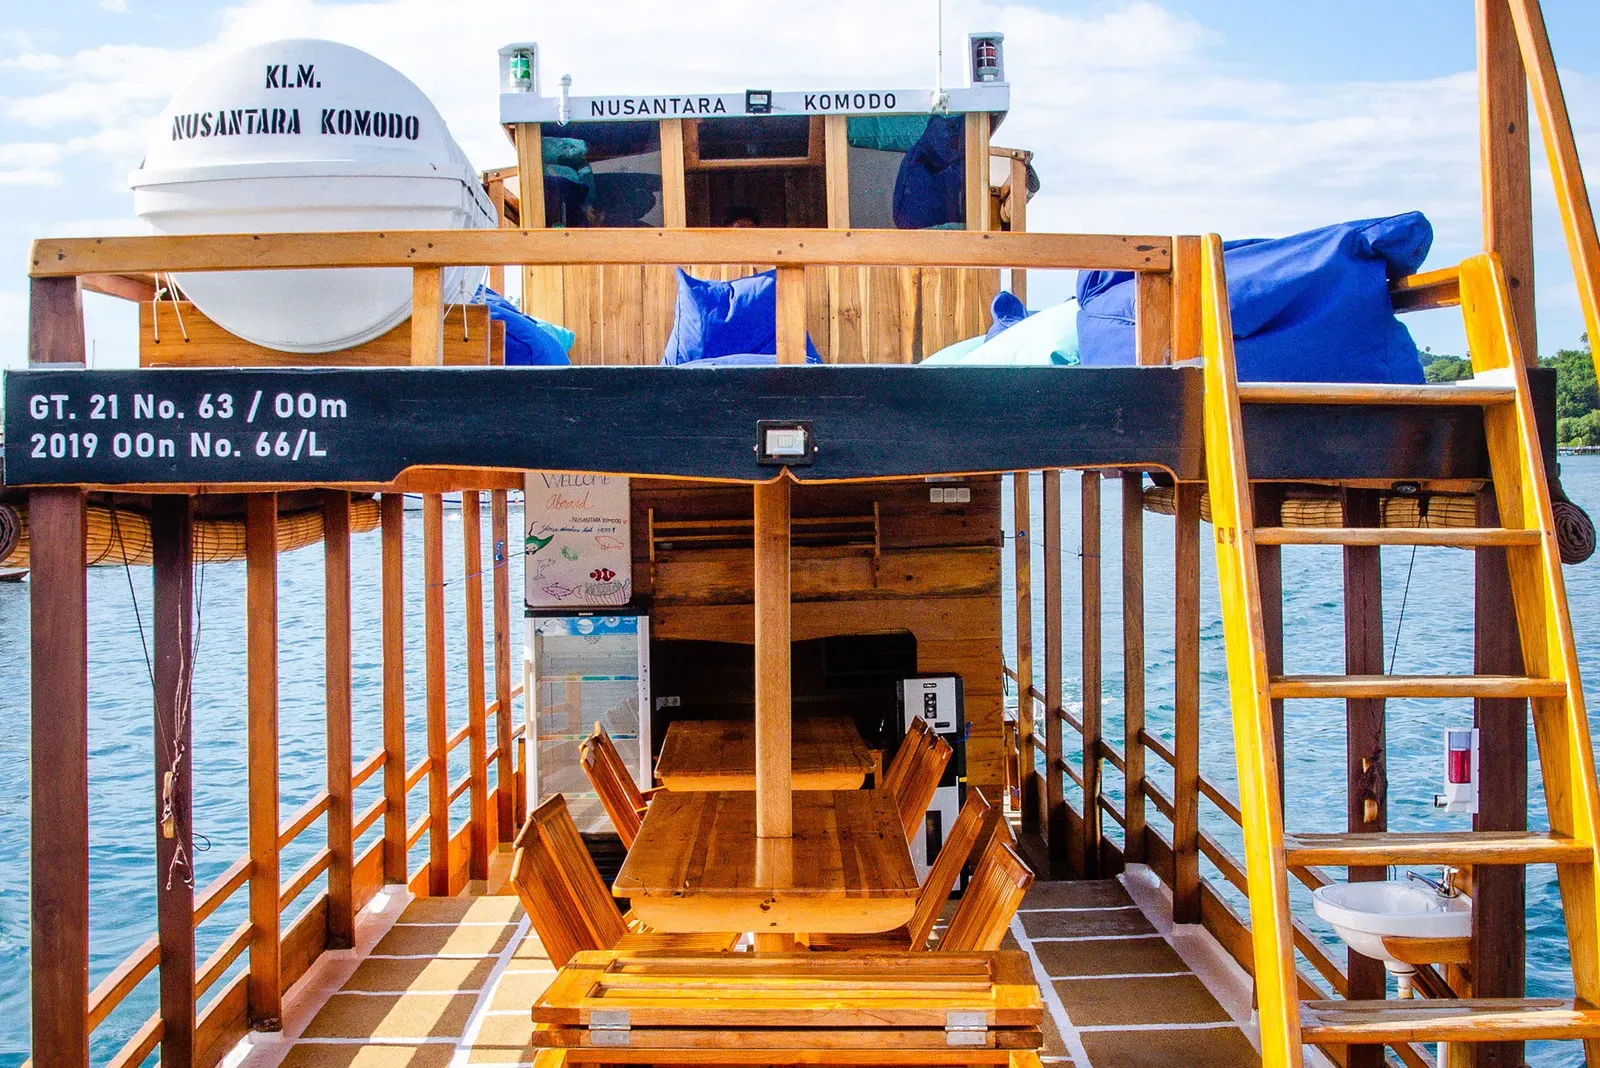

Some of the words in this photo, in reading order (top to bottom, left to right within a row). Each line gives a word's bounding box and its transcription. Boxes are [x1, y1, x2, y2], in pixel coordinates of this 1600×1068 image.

[591, 97, 727, 117] NUSANTARA
[804, 92, 896, 111] KOMODO
[172, 108, 301, 141] NUSANTARA
[321, 108, 420, 141] KOMODO
[29, 394, 76, 420] GT.
[89, 393, 118, 420] 21
[133, 393, 185, 420] No.
[198, 393, 234, 419] 63
[246, 390, 263, 423] /
[30, 432, 98, 459] 2019
[190, 431, 241, 458] No.
[255, 428, 327, 461] 66/L
